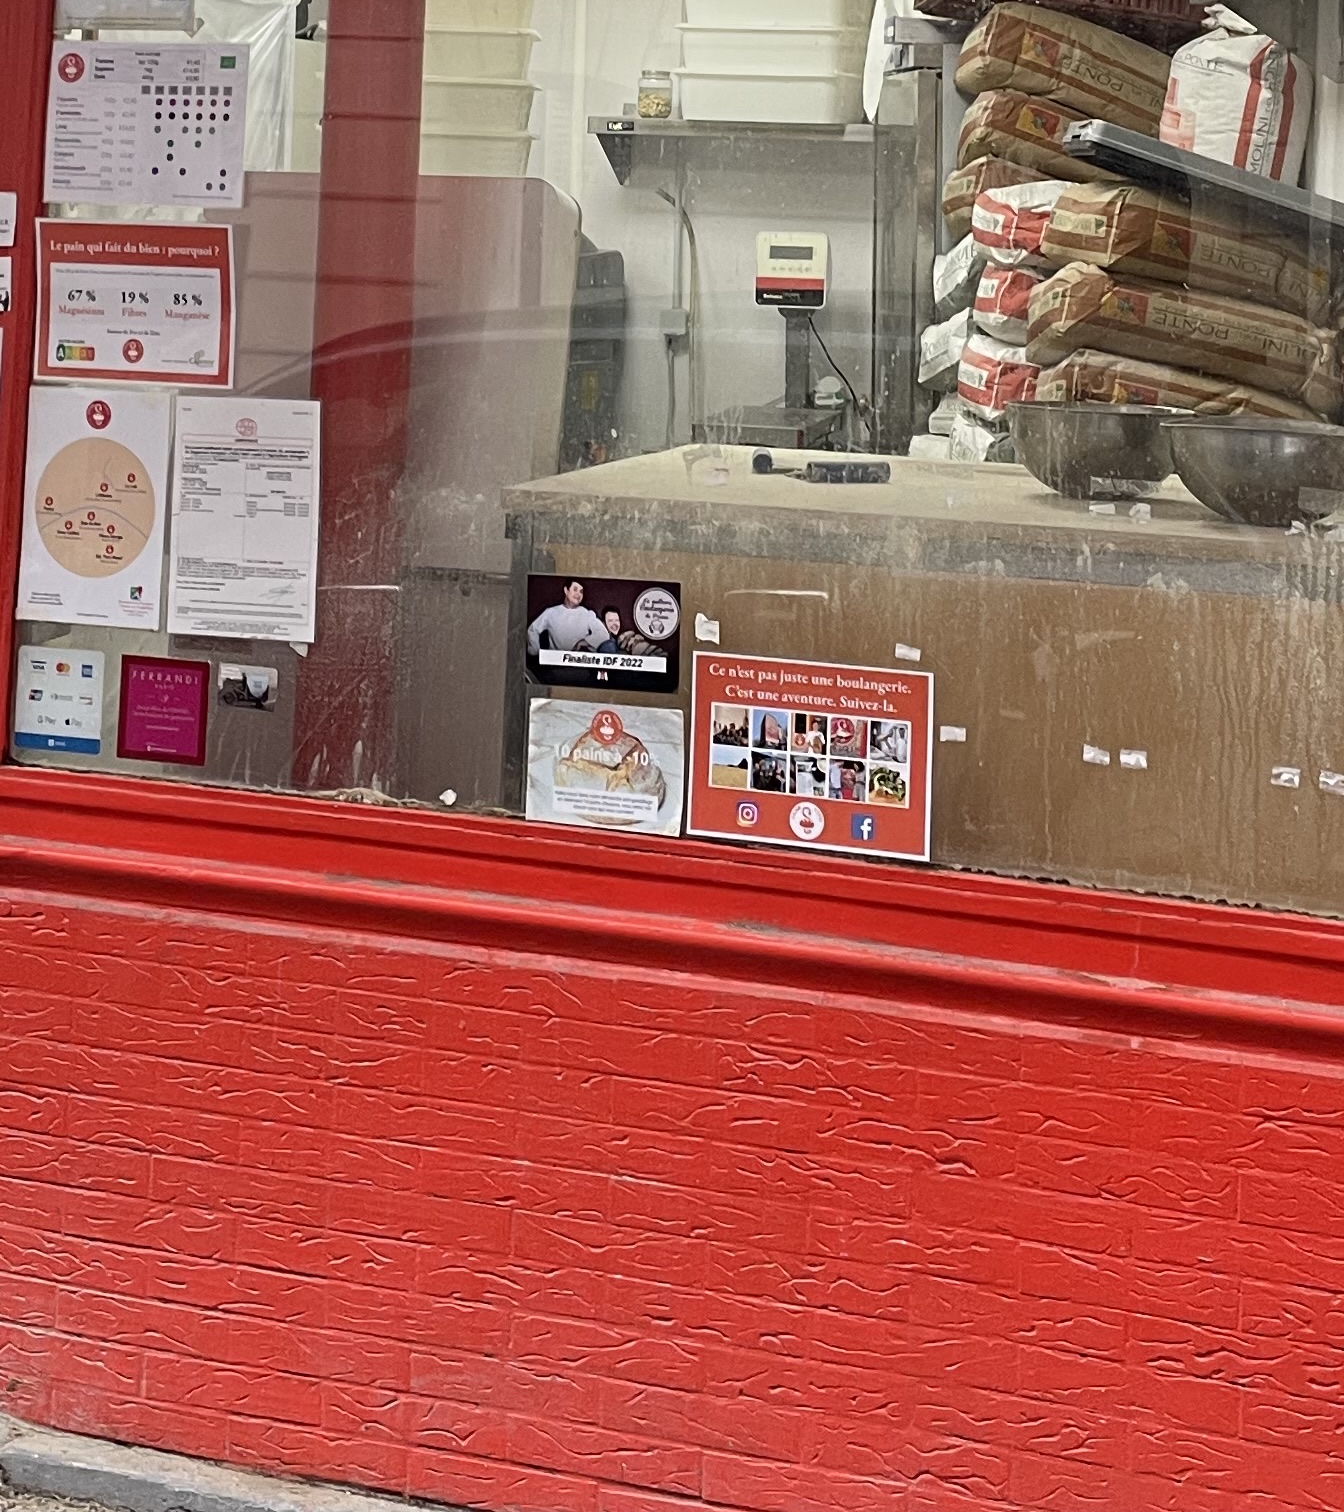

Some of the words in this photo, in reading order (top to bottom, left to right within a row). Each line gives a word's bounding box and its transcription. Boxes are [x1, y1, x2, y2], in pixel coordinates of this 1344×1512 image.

[50, 239, 62, 251] Le
[63, 240, 85, 254] pain
[86, 241, 103, 255] qui
[105, 240, 122, 252] fait
[123, 241, 136, 253] du
[138, 242, 160, 254] bien
[167, 245, 212, 259] pourquoi
[67, 289, 83, 302] 67
[85, 289, 97, 302] %
[121, 291, 136, 304] 19
[138, 291, 150, 304] %
[173, 293, 188, 306] 85
[191, 293, 203, 306] %
[1262, 337, 1320, 359] OLINI
[562, 653, 601, 665] Finaliste
[603, 656, 618, 666] IDF
[620, 657, 644, 668] 2022
[709, 663, 726, 676] Ce
[728, 665, 755, 679] n'est
[758, 670, 777, 683] pas
[779, 669, 809, 685] juste
[811, 676, 834, 686] une
[836, 674, 912, 695] boulangerie.
[725, 684, 754, 698] C'est
[757, 690, 780, 701] une
[781, 693, 837, 707] aventure.
[839, 695, 898, 713] Suivez-la.
